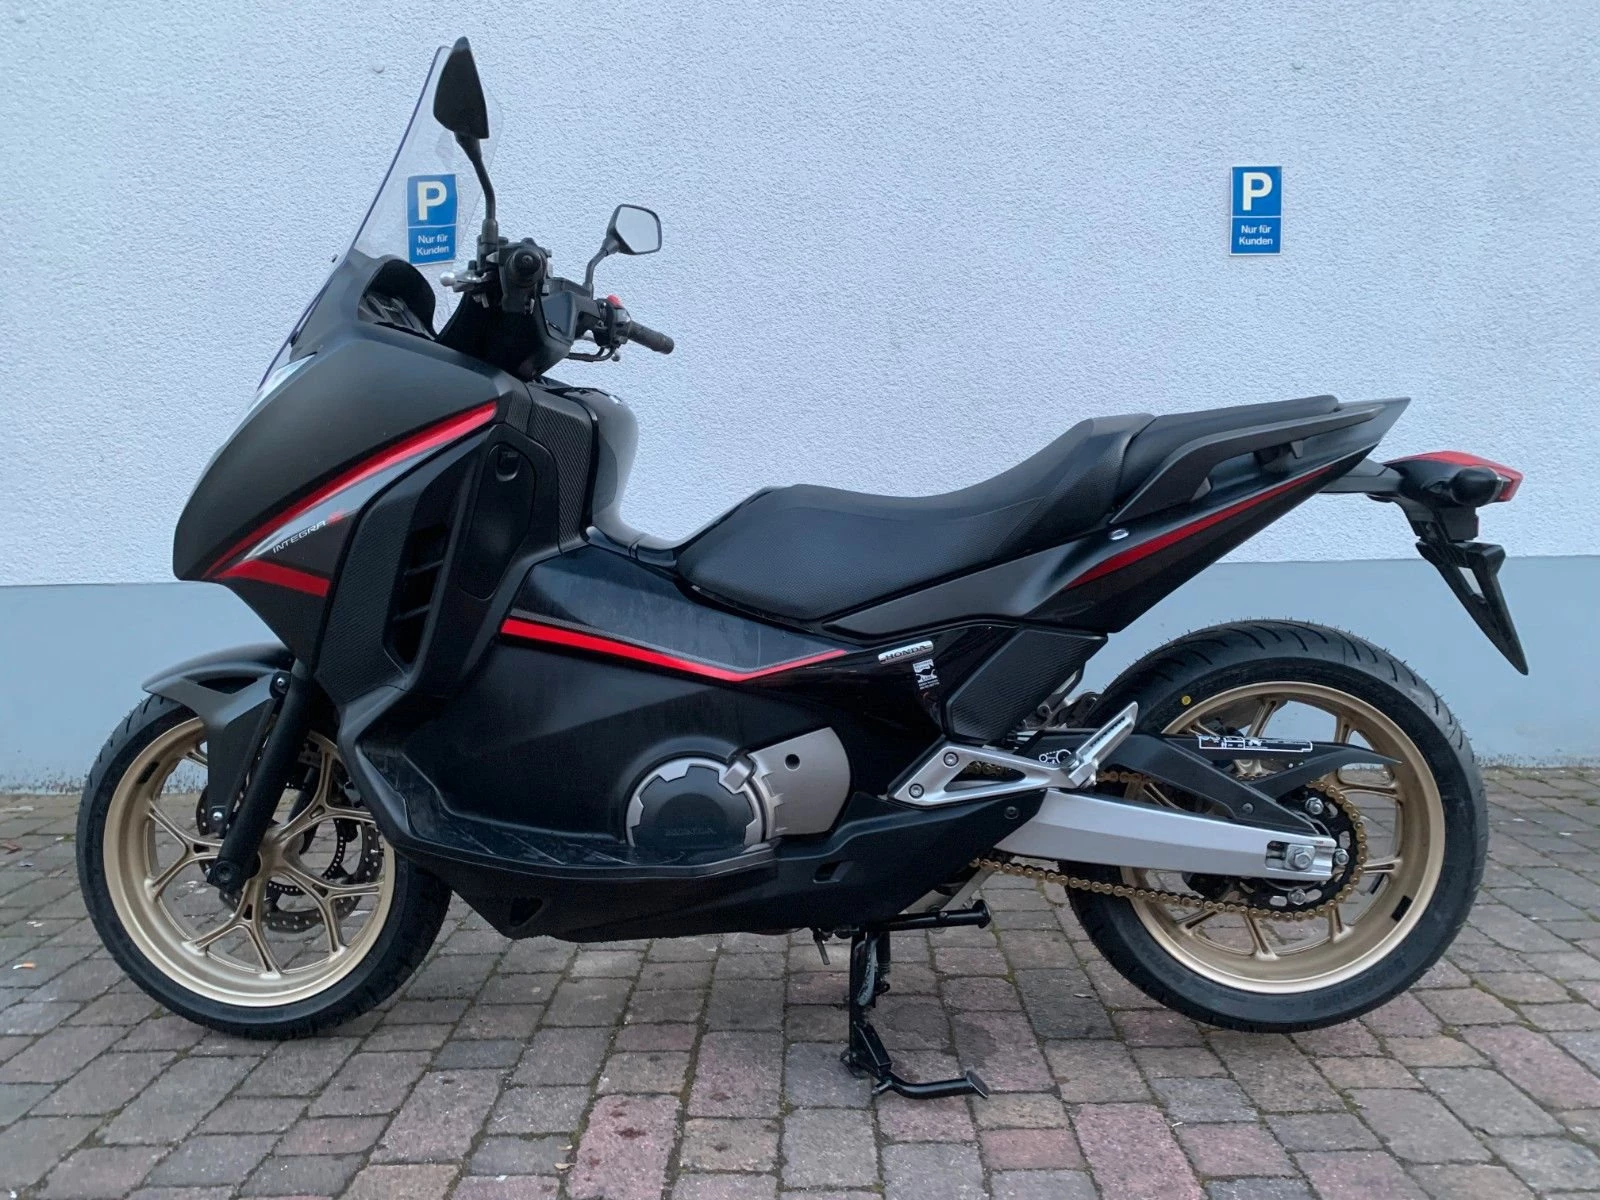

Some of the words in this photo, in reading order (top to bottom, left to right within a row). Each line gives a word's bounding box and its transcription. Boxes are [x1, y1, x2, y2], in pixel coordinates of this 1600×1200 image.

[1242, 172, 1273, 211] P
[417, 181, 447, 221] P
[1241, 225, 1257, 234] Nur
[1259, 224, 1272, 234] für
[417, 235, 435, 244] Nur
[436, 234, 448, 243] für
[1238, 236, 1273, 246] Kunden
[416, 246, 449, 256] Kunden
[272, 520, 328, 554] INTEGRA
[884, 645, 929, 661] HONDA
